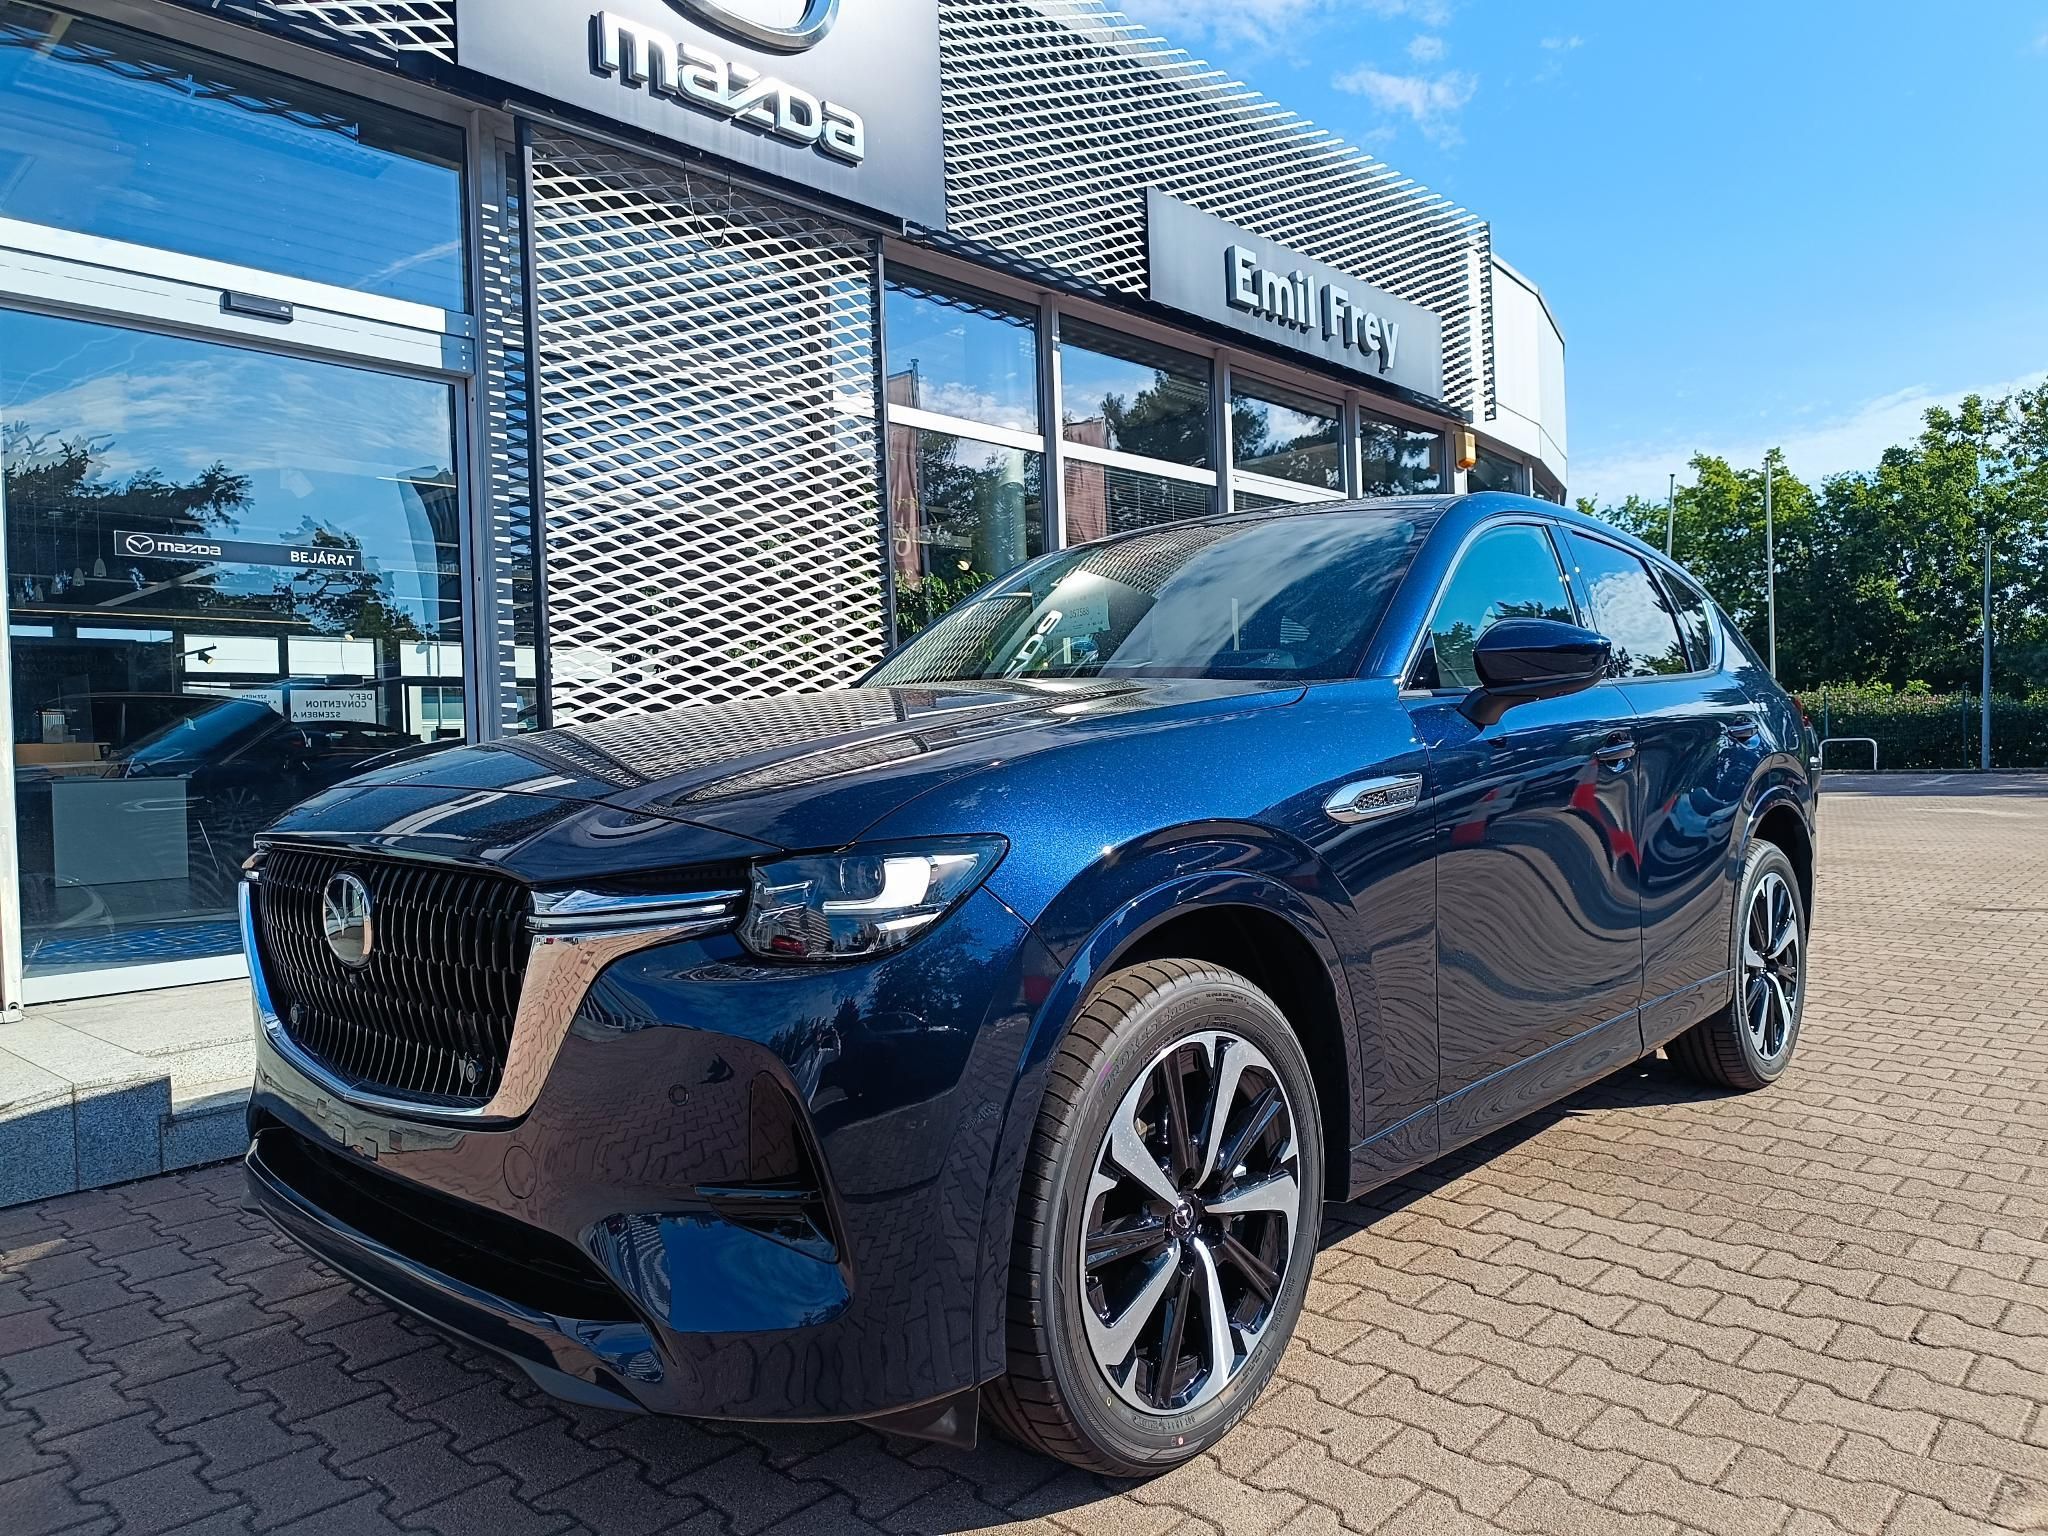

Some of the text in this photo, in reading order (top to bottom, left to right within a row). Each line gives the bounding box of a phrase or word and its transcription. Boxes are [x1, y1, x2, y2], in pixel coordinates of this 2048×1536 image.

[594, 10, 865, 166] mazda
[1227, 244, 1400, 373] Emil Frey
[157, 541, 222, 556] mazda
[290, 550, 355, 566] BEJÁRAT
